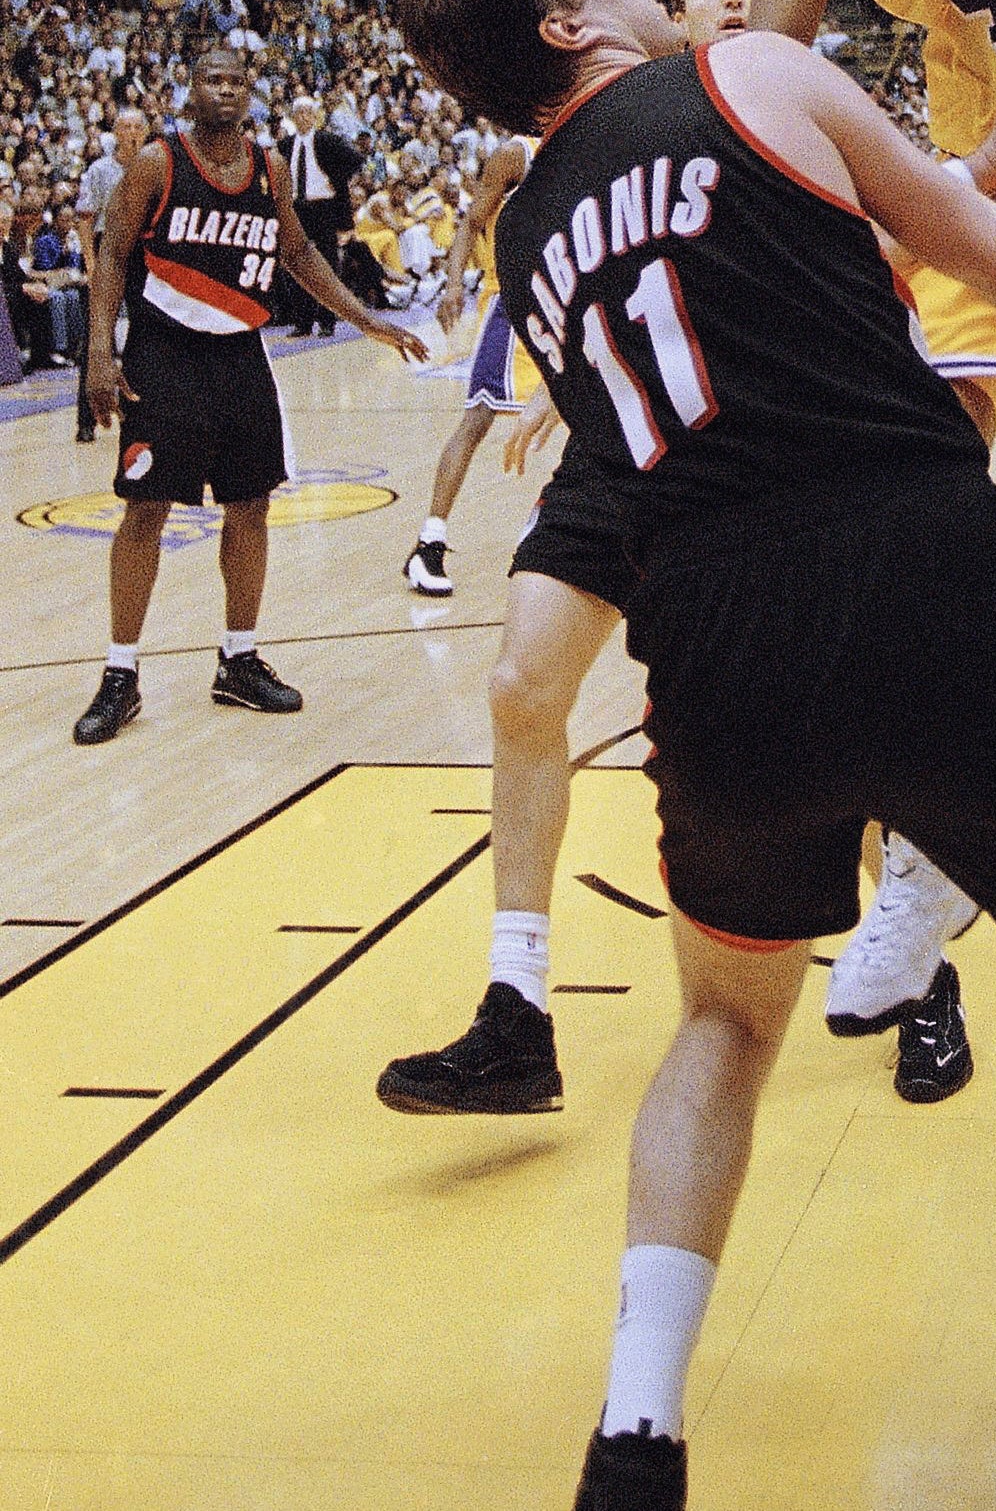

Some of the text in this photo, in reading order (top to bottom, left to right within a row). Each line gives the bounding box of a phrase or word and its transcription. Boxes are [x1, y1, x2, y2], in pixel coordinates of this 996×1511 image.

[167, 206, 280, 252] BLAZERS
[238, 253, 277, 292] 34
[525, 156, 720, 374] SABONIS
[582, 255, 721, 472] 11
